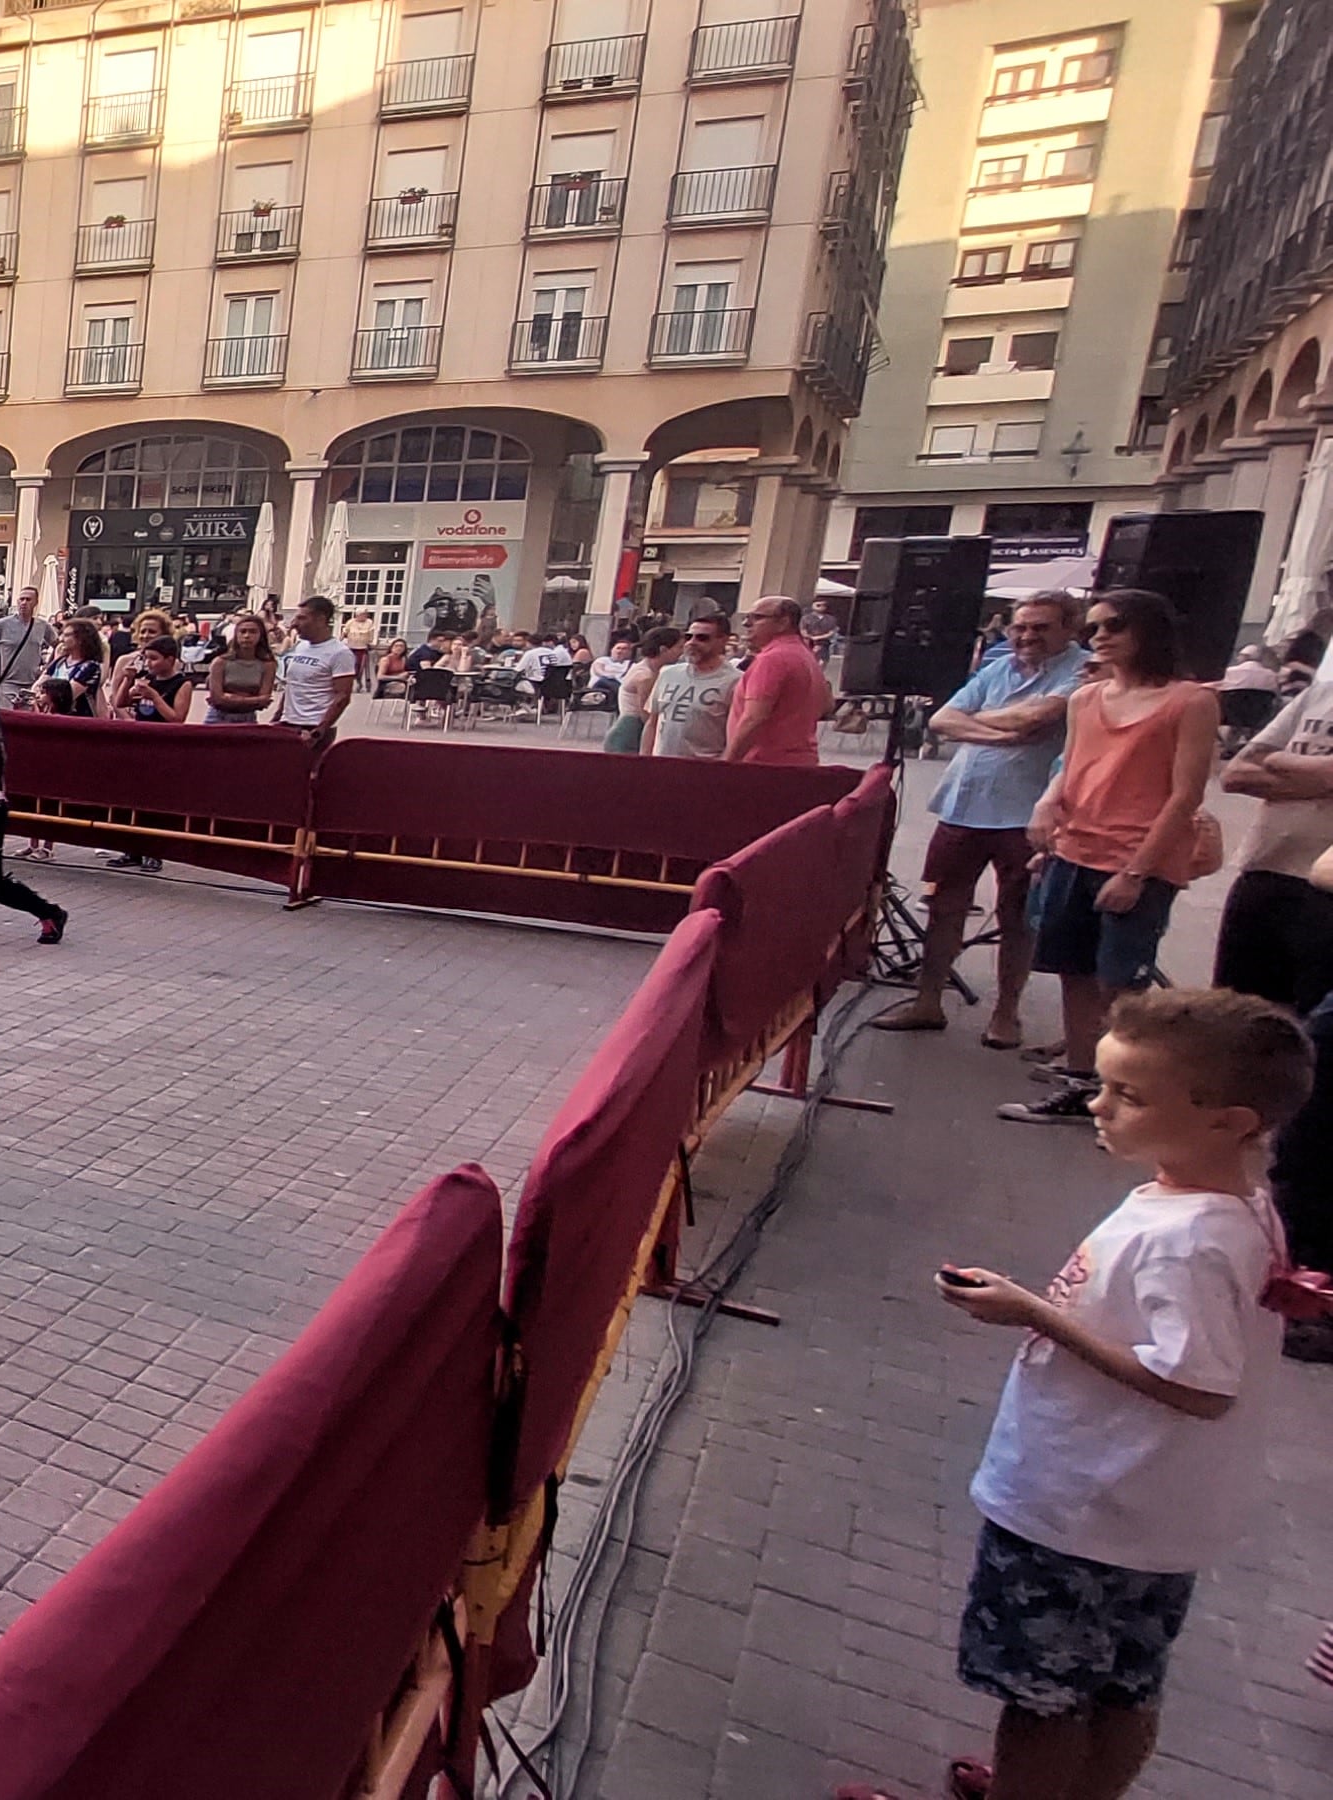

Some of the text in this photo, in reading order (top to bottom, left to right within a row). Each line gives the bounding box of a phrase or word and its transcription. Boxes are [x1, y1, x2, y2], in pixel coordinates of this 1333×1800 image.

[183, 521, 247, 537] MIRA
[437, 524, 507, 536] vodafone
[662, 684, 721, 706] HAC
